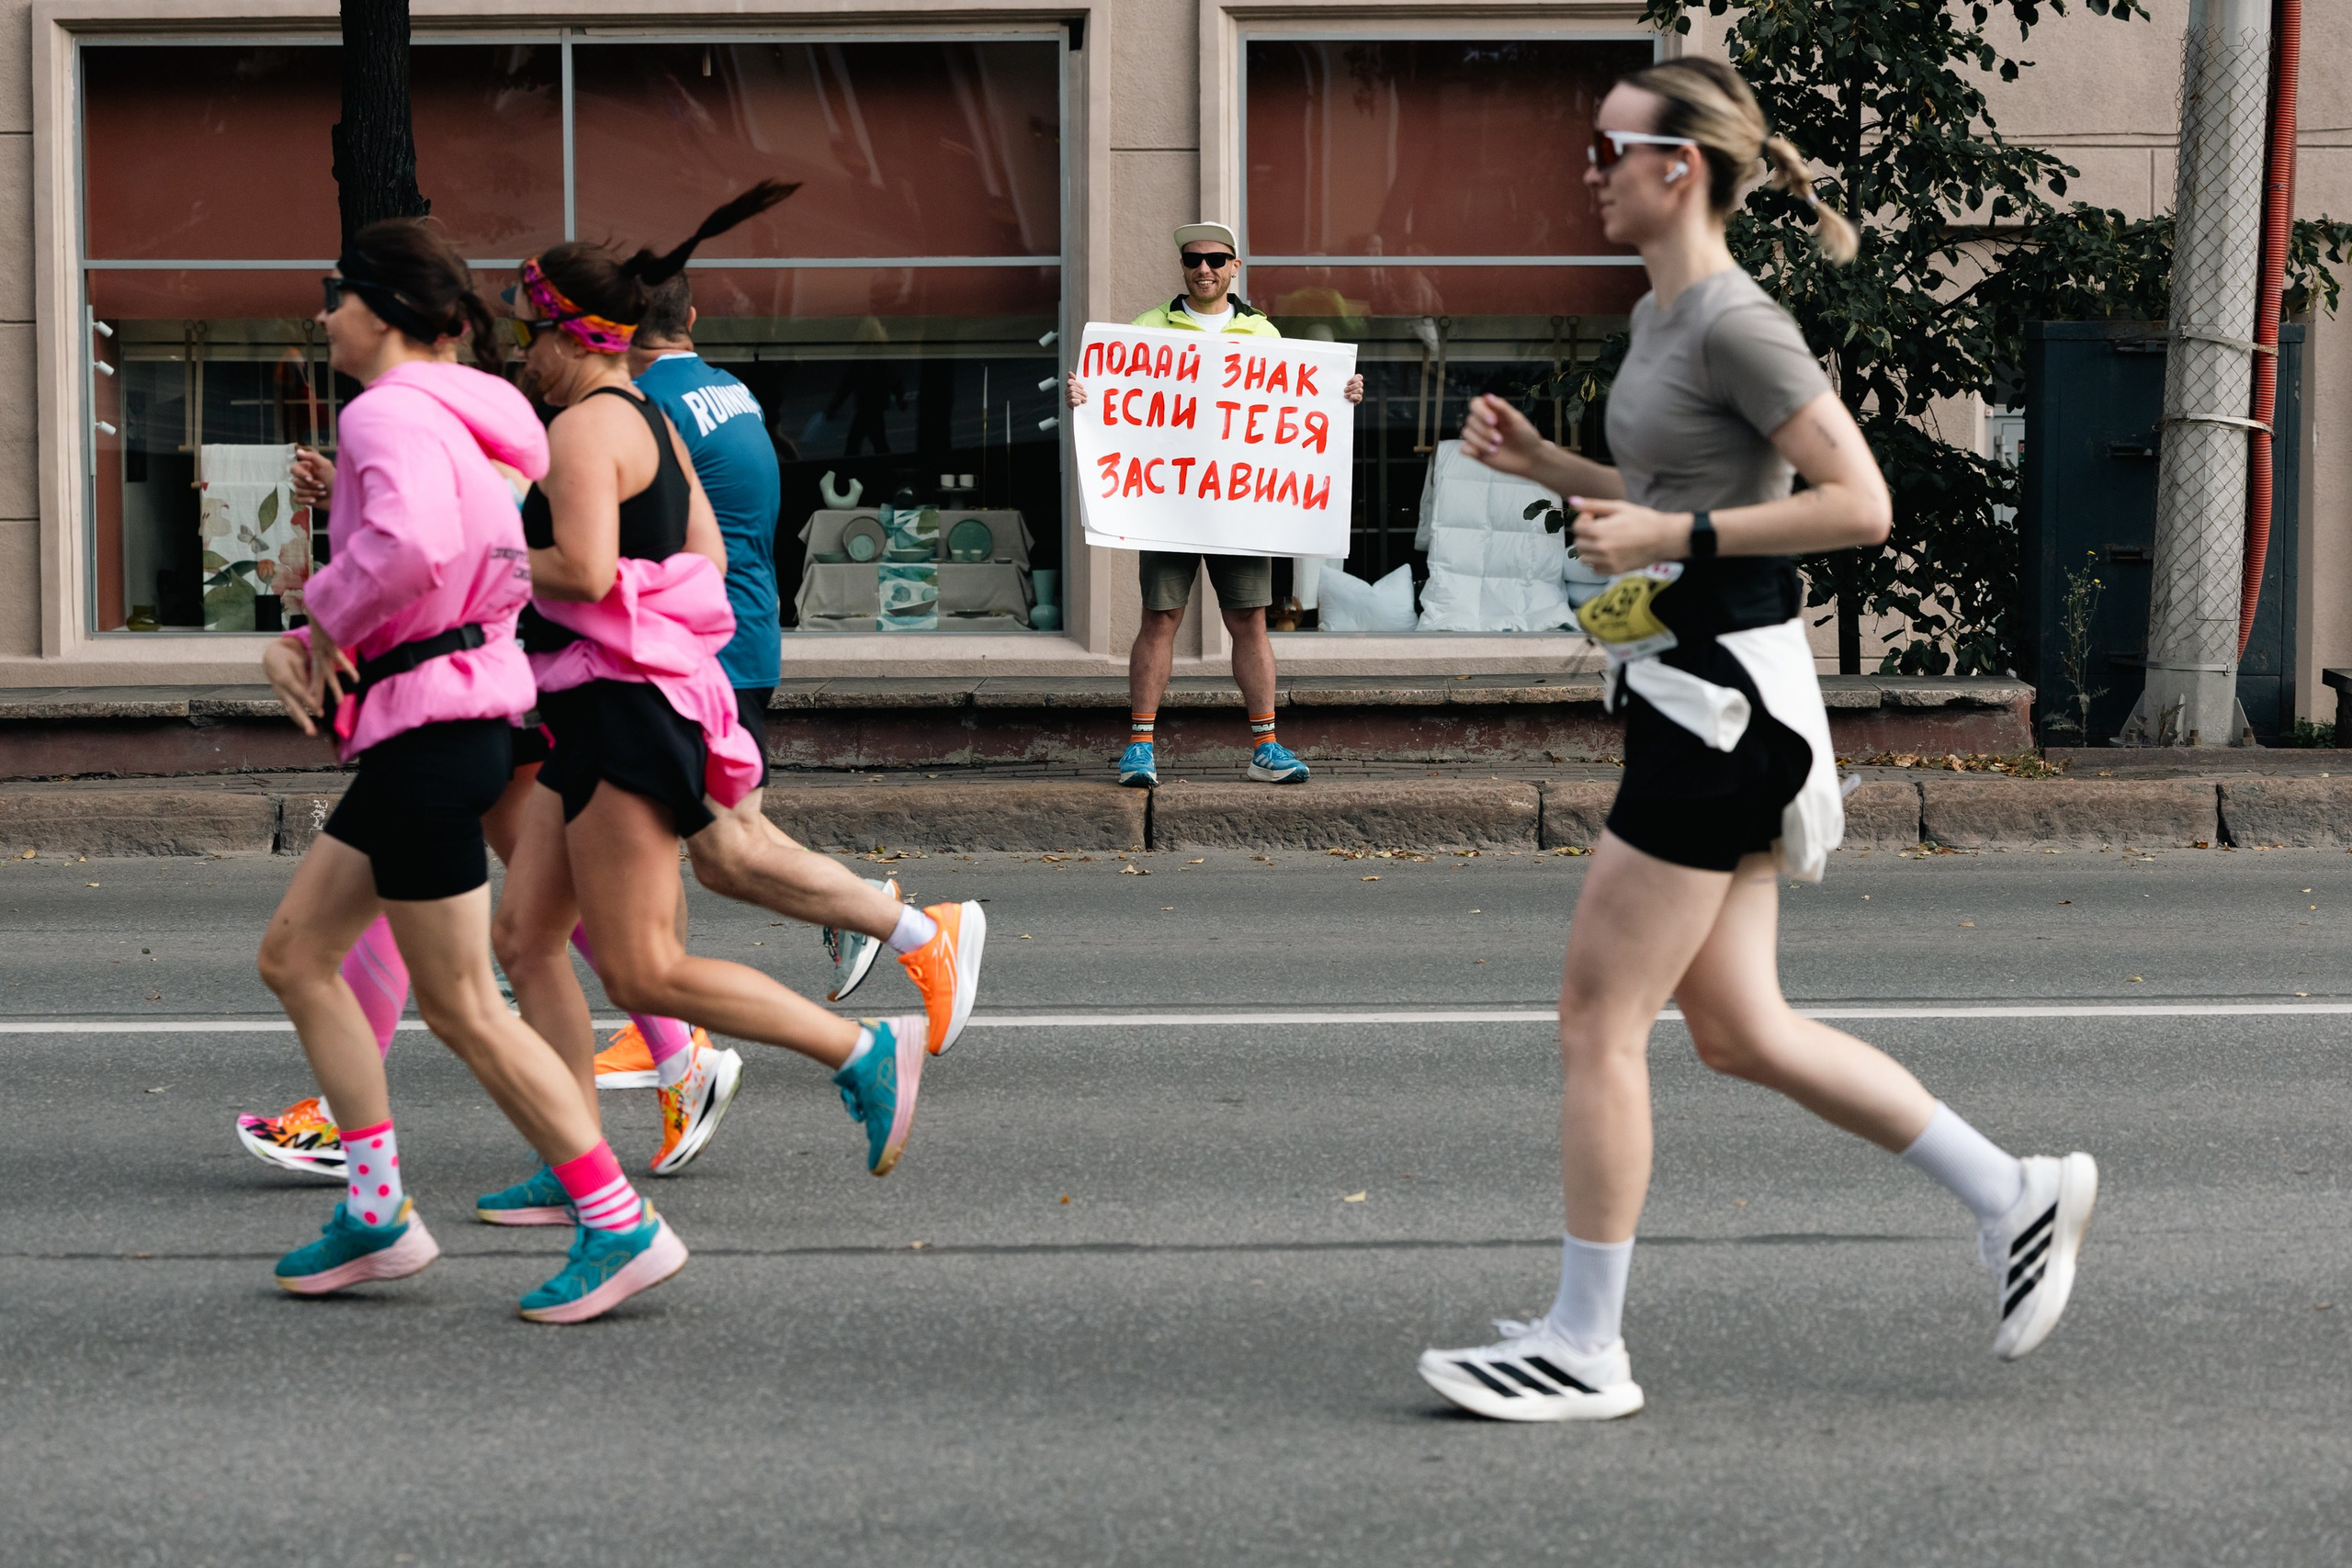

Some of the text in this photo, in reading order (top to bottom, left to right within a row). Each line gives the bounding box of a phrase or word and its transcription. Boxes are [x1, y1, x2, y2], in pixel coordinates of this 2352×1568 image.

[1082, 340, 1319, 398] ПОДАЙ ЗНАК
[1102, 388, 1329, 455] ЕСЛИ ТЕБЯ
[1096, 451, 1331, 511] ЗАСТАВИЛИ
